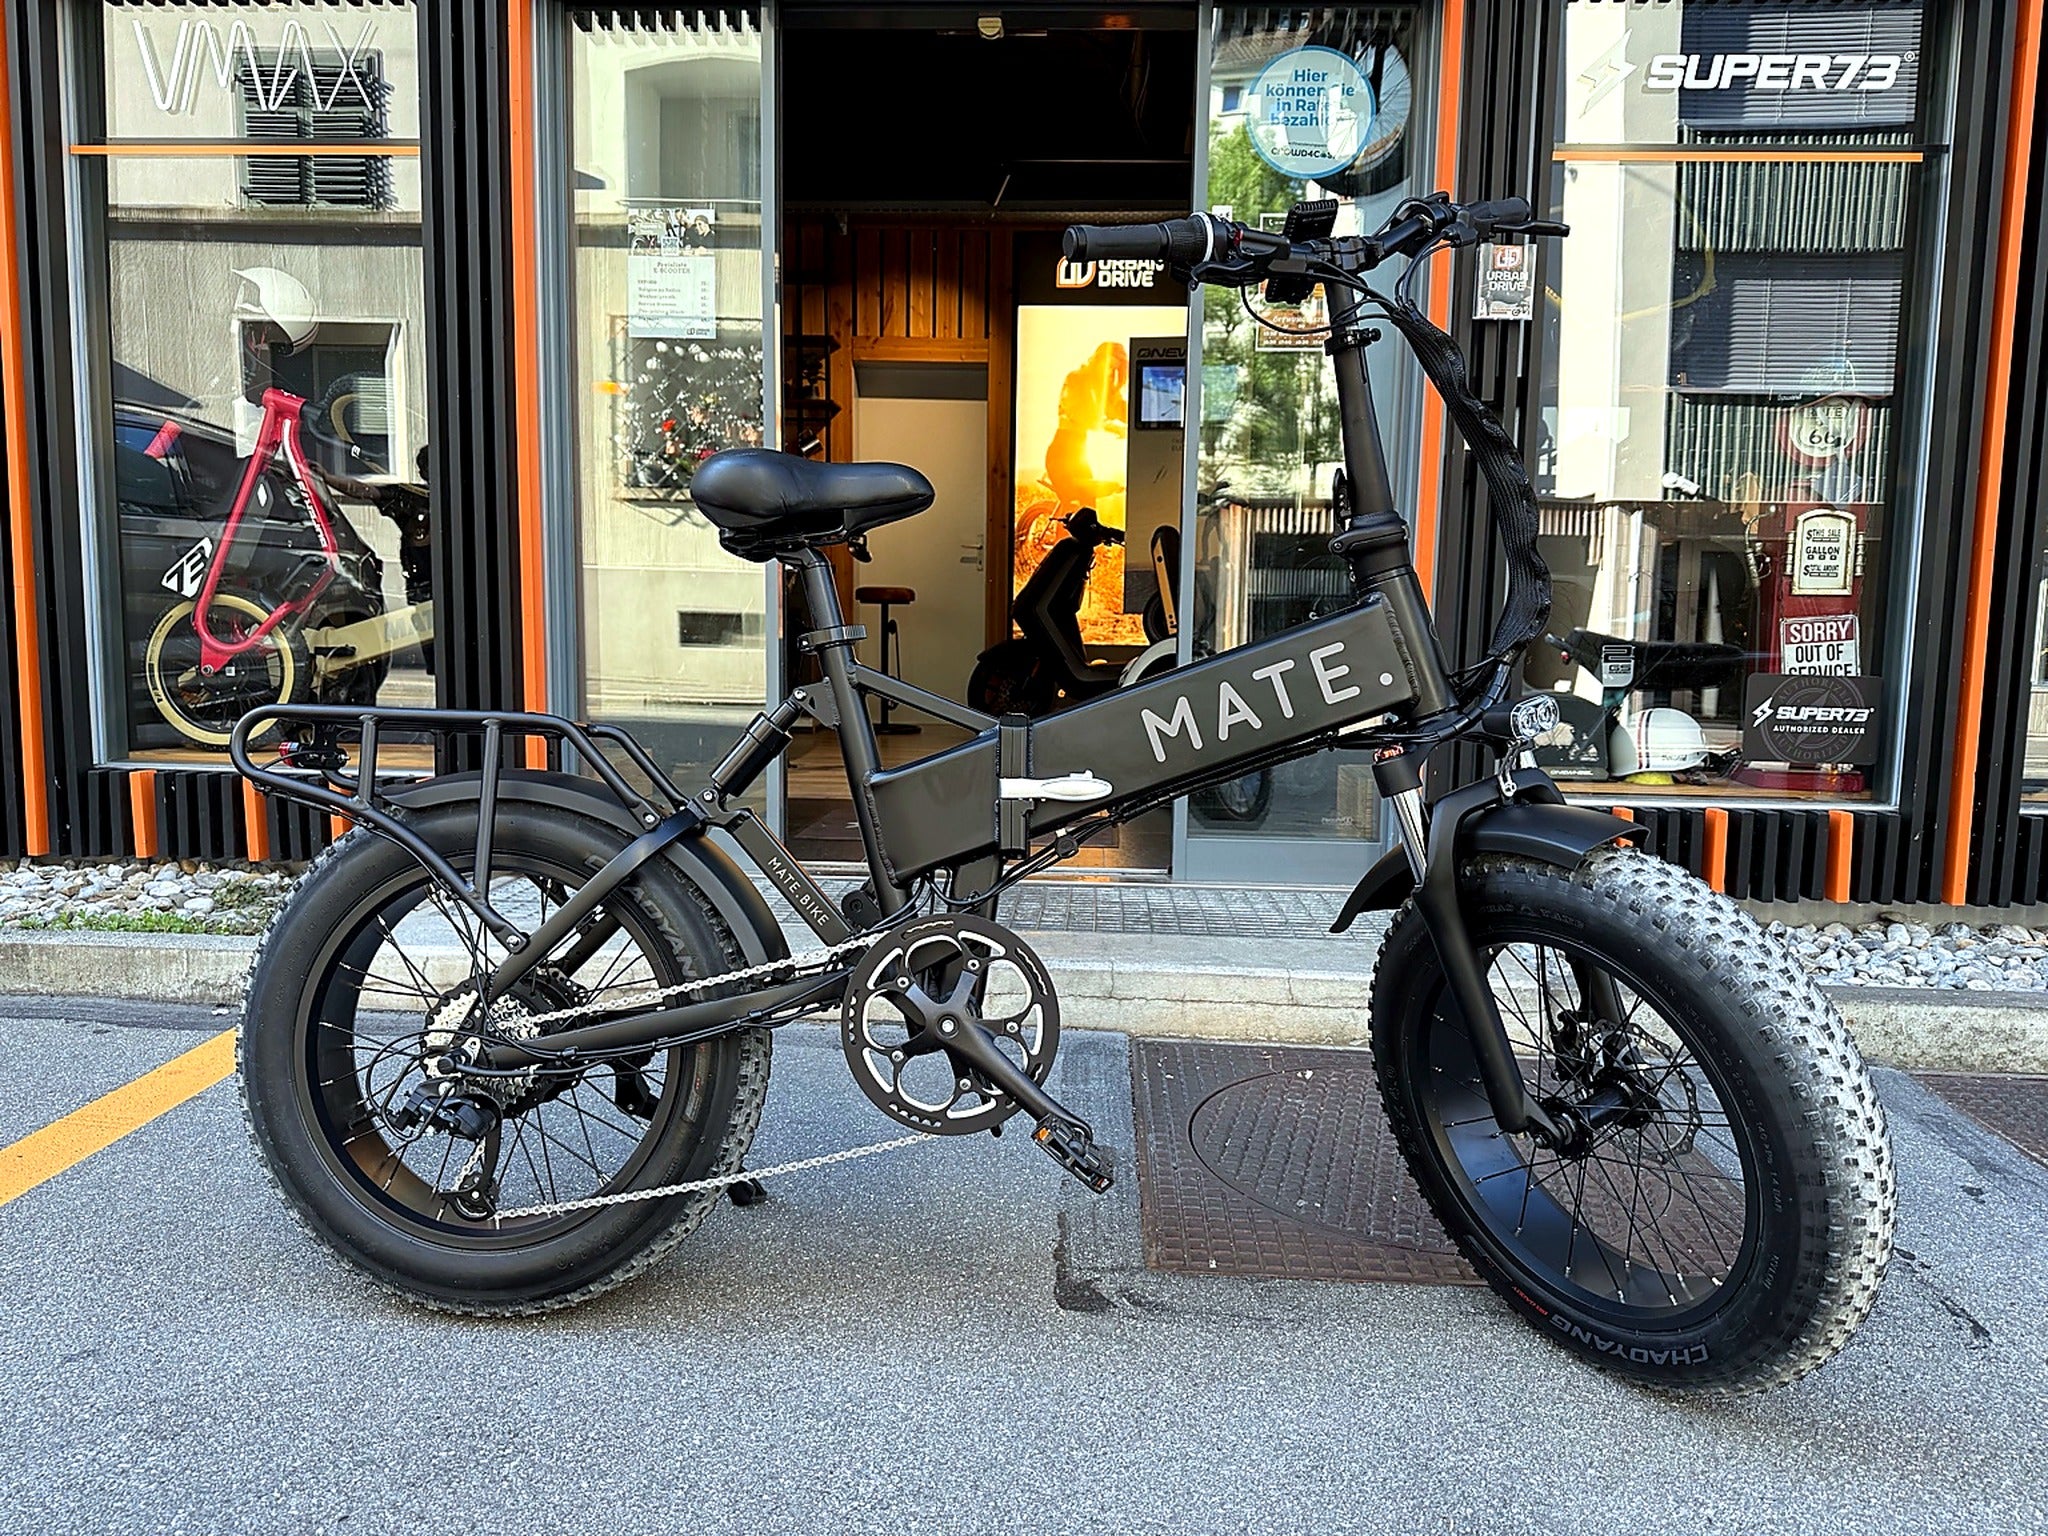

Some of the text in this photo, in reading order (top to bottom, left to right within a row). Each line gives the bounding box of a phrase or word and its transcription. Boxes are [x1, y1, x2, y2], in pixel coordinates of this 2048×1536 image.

[132, 19, 375, 112] VMAX
[1294, 69, 1328, 82] Hier
[1332, 84, 1355, 97] ie
[1276, 98, 1291, 111] in
[1098, 270, 1154, 288] DRIVE
[1486, 270, 1528, 281] URBAN
[1489, 281, 1526, 291] DRIVE
[1805, 546, 1840, 555] GALLON
[1789, 620, 1850, 643] SORRY
[1795, 643, 1844, 663] OUT OF
[1141, 641, 1393, 763] MATE.
[1773, 724, 1865, 735] AUTHORIZED DEALER
[768, 856, 830, 927] MATE.BIKE
[1549, 1313, 1709, 1366] CHAOYANG
